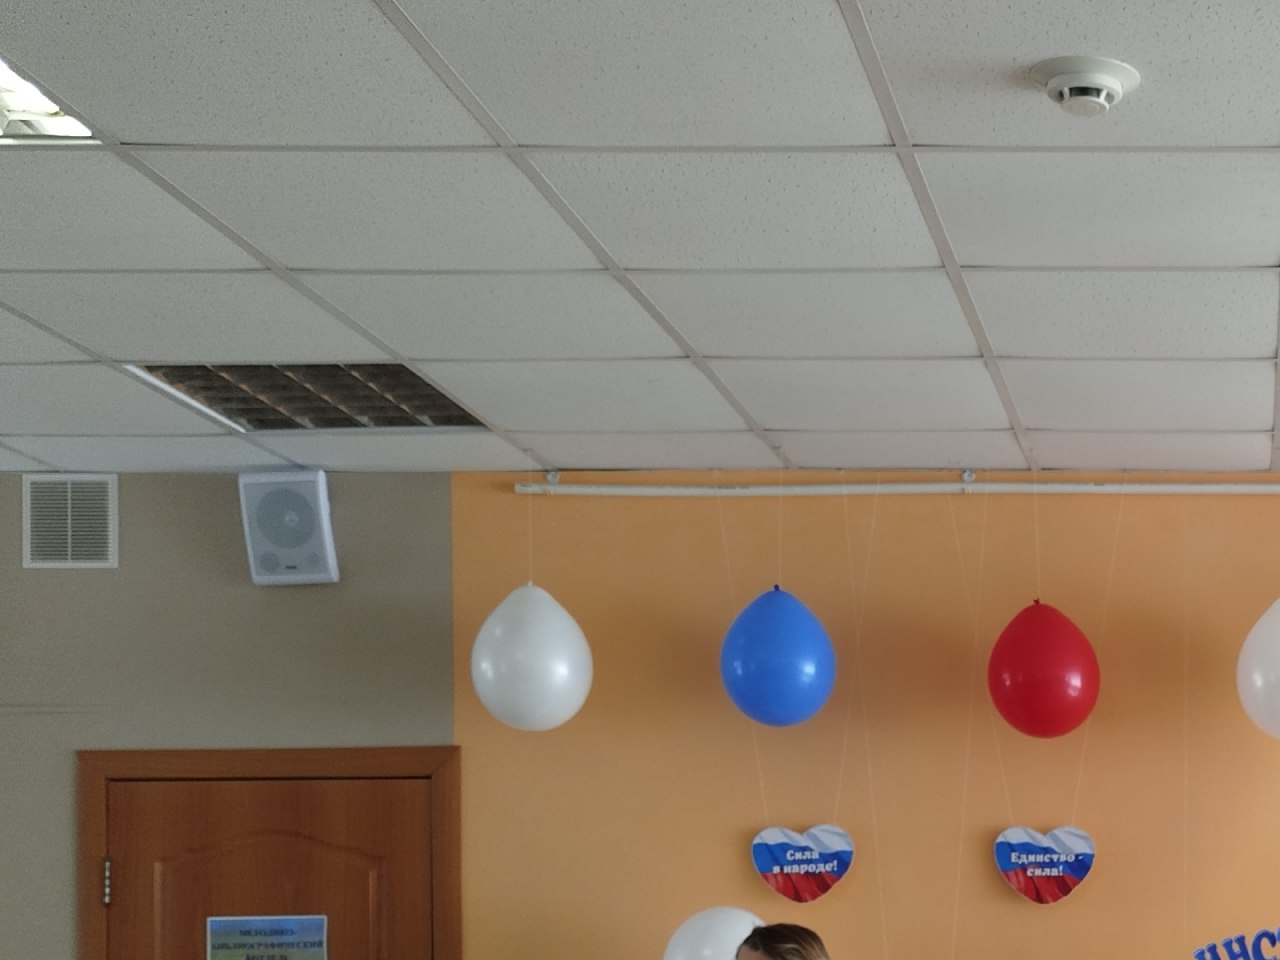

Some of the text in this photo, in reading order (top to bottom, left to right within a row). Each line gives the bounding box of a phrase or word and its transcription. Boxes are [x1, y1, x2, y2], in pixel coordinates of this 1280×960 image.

[786, 850, 819, 860] Сила
[1010, 852, 1076, 864] Единство
[783, 860, 838, 874] народе!
[1026, 865, 1063, 877] сила!
